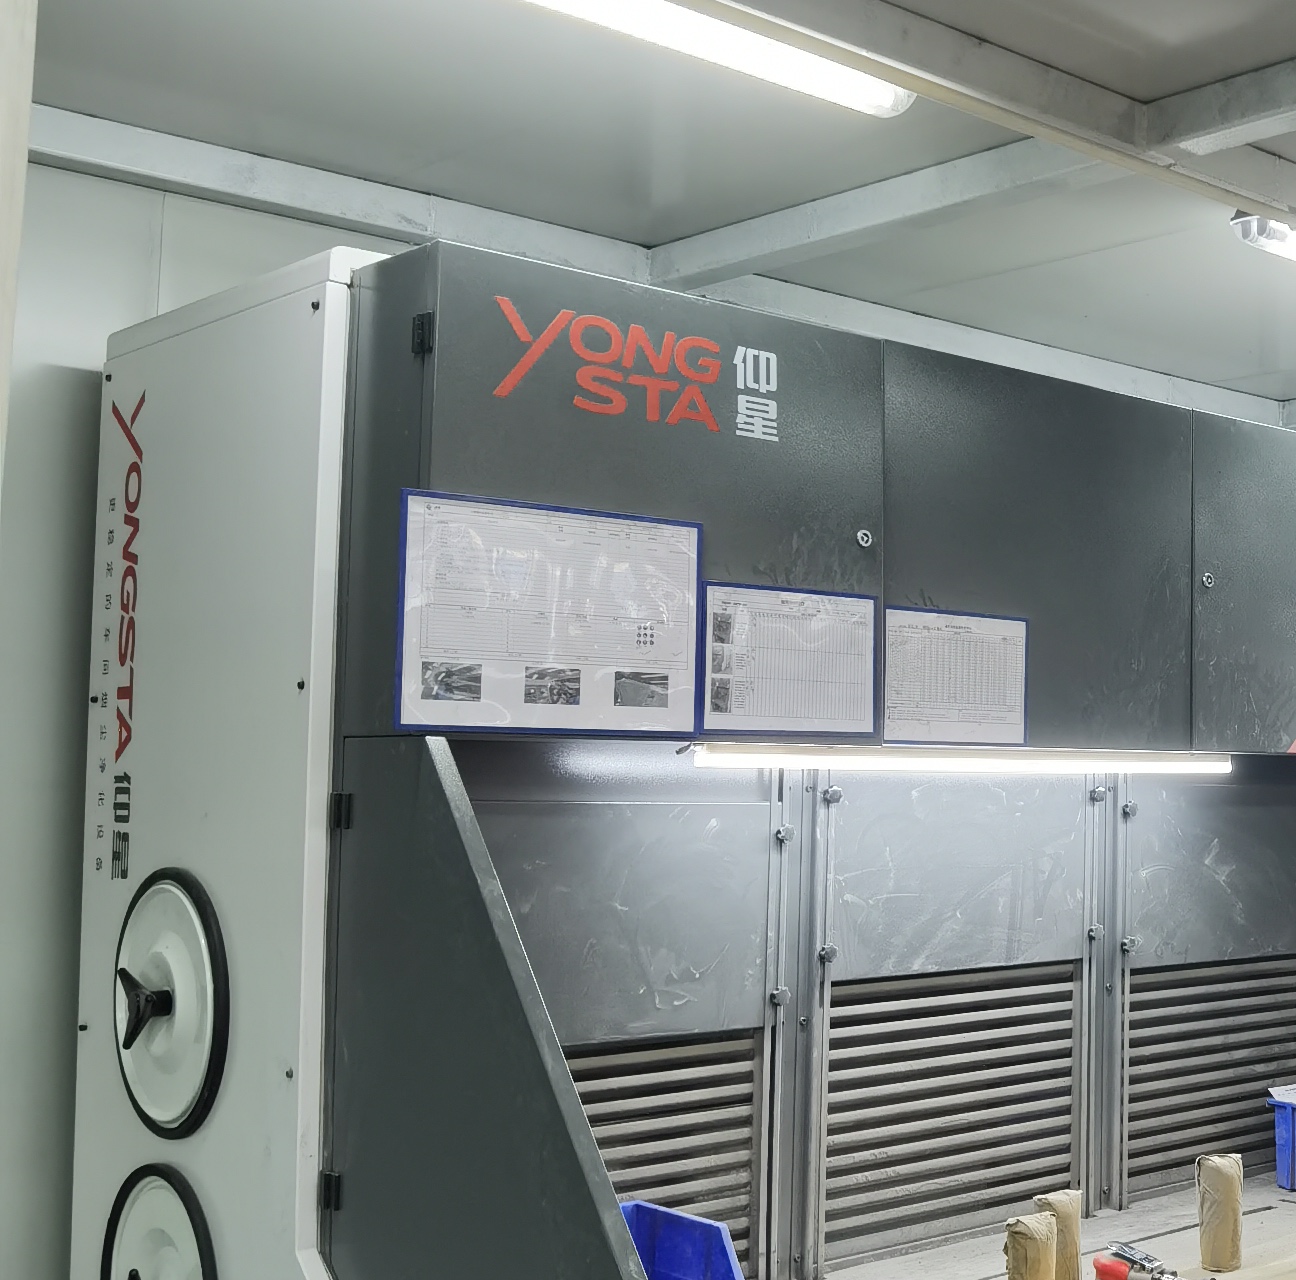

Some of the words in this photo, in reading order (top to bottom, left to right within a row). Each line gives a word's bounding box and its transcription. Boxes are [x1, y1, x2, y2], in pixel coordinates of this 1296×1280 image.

[494, 295, 722, 397] YONG
[733, 345, 779, 442] 仰星
[573, 365, 721, 432] STA
[113, 390, 146, 764] YONGSTA
[112, 771, 132, 880] 仰星
